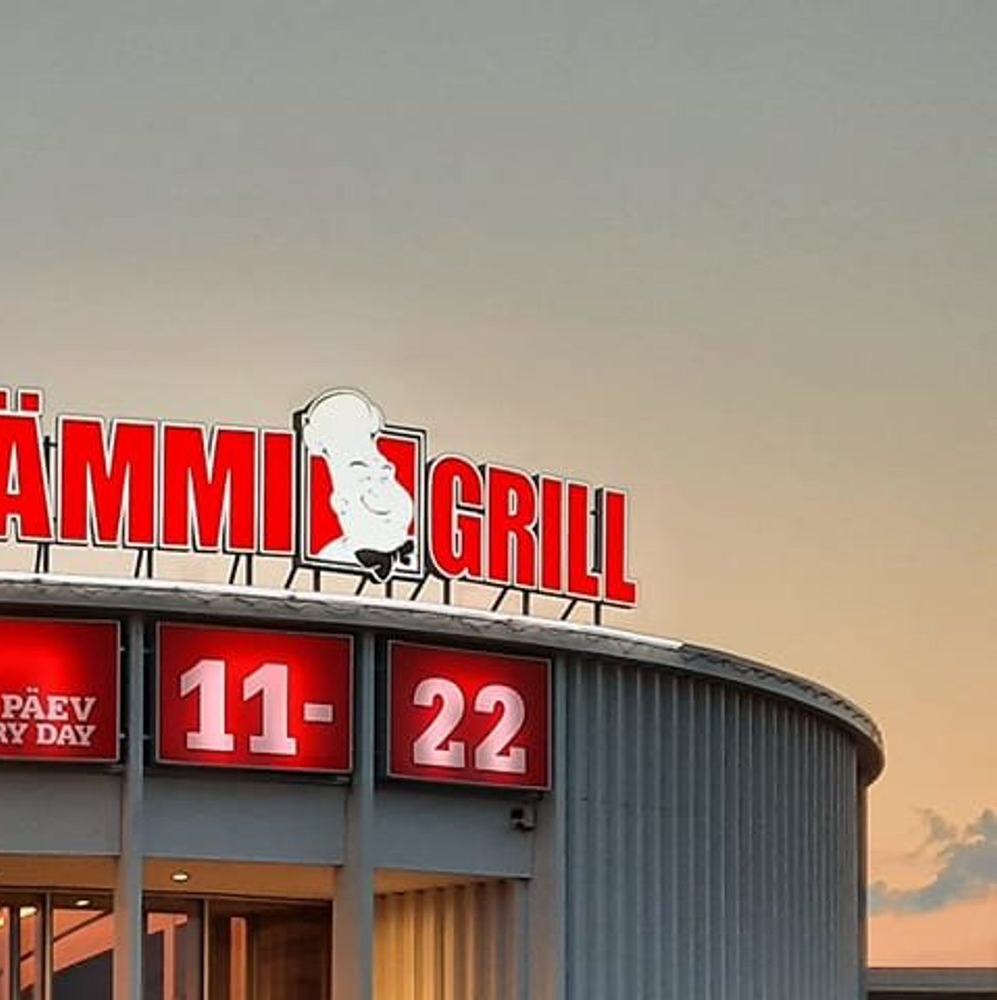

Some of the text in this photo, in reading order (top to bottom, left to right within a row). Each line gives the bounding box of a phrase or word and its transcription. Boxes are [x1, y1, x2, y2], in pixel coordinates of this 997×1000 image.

[427, 454, 638, 608] GRILL
[1, 687, 96, 722] PÄEV
[36, 723, 96, 746] DAY
[413, 677, 527, 774] 22
